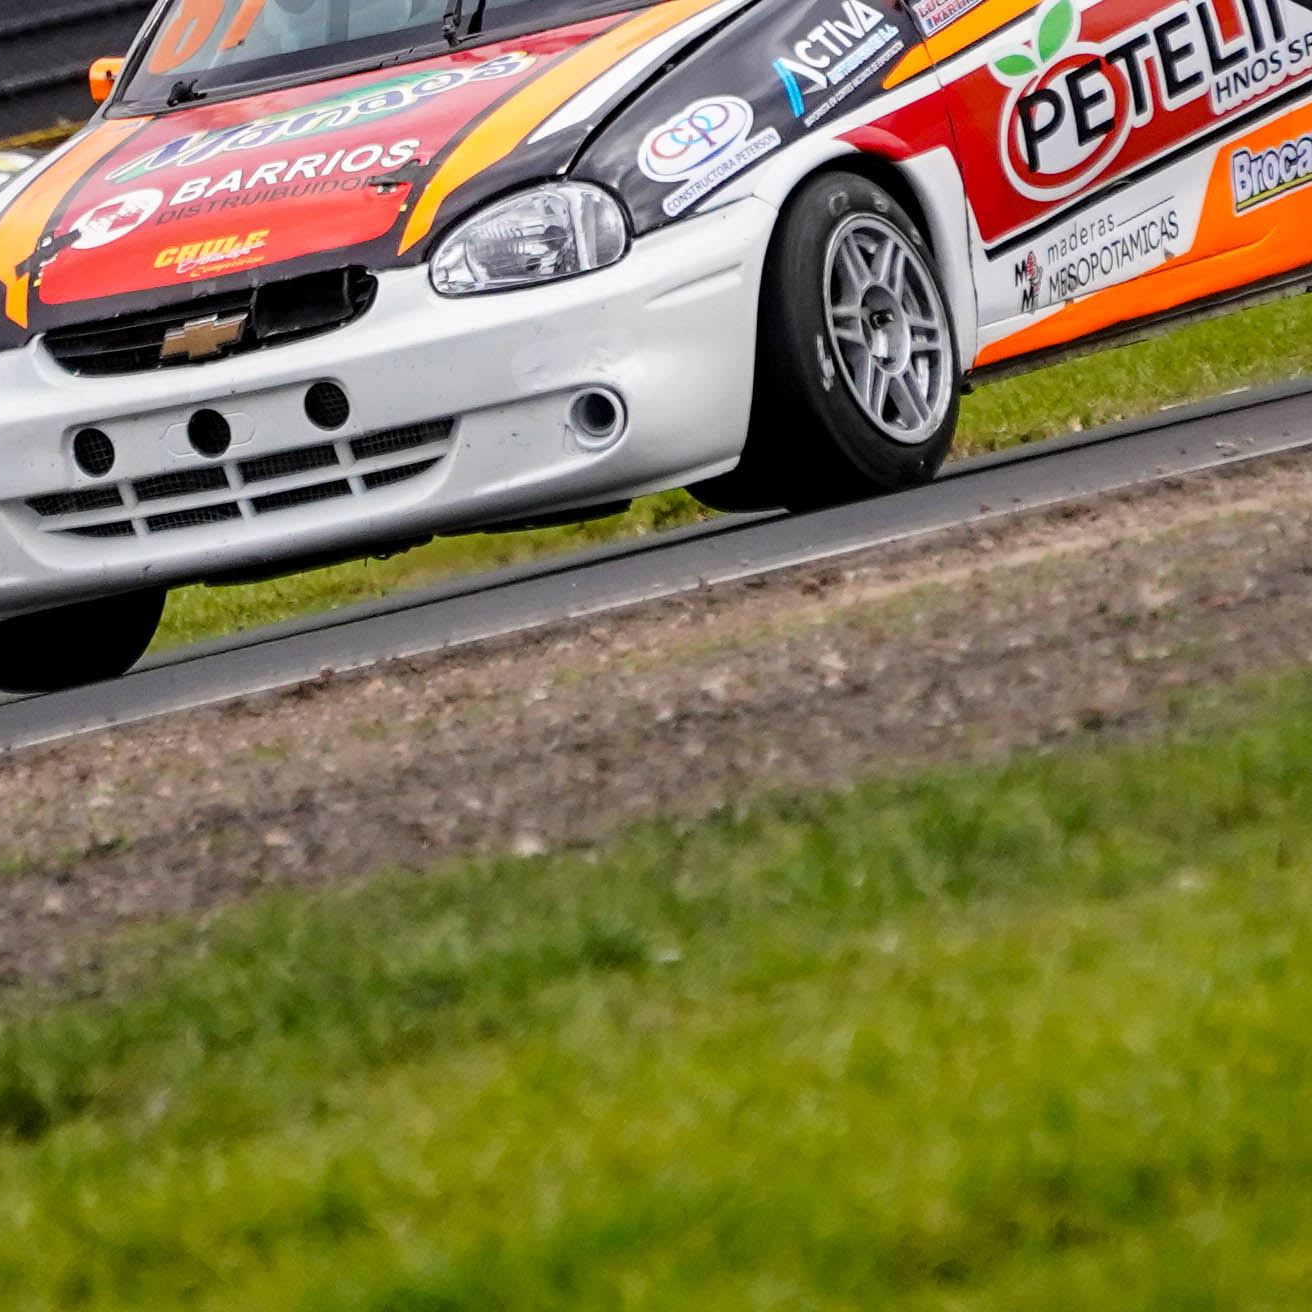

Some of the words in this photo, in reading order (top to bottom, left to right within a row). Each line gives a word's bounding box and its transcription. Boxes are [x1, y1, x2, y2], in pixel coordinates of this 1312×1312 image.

[1214, 51, 1284, 107] HNOS
[169, 138, 422, 207] BARRIOS
[666, 158, 737, 213] CONSTRUCTORA
[735, 132, 778, 166] PETERSON
[1046, 212, 1116, 265] maderas
[1048, 209, 1181, 305] MESOPOTAMICAS
